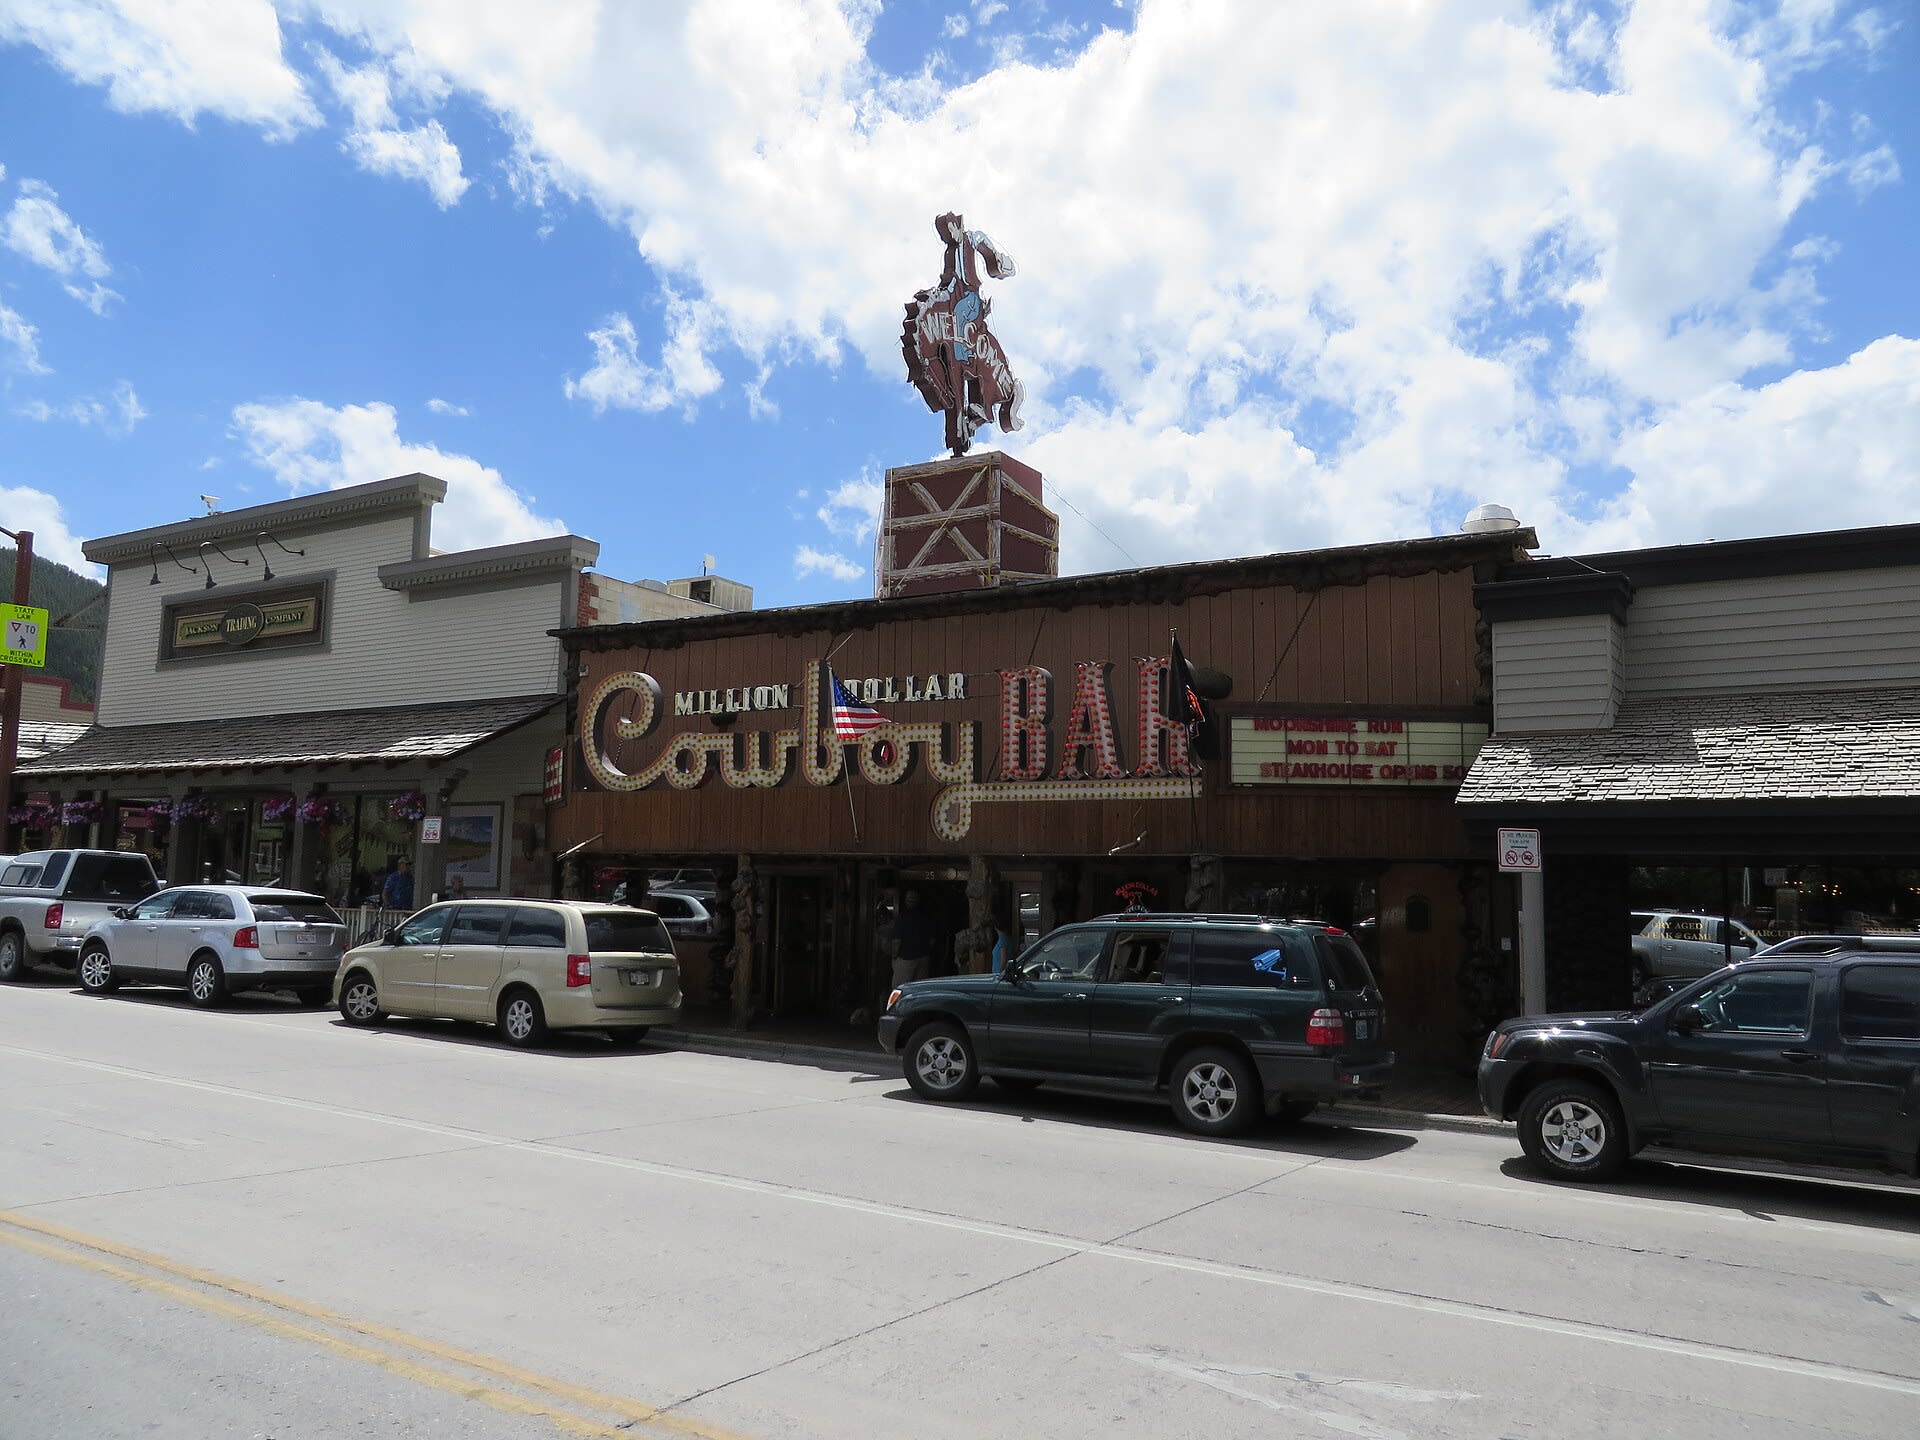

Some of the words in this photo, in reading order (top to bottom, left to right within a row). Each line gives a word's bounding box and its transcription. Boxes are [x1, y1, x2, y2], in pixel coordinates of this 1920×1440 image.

[921, 311, 1014, 400] WELCOME
[14, 606, 35, 615] STATE
[25, 624, 36, 635] TO
[184, 623, 218, 636] JACKSON
[226, 615, 257, 633] TRADING
[265, 611, 305, 626] COMPANY
[9, 649, 33, 658] WITHIN
[675, 683, 790, 716] MILLION
[1367, 719, 1404, 734] RUN
[582, 658, 980, 842] Cowboy
[998, 656, 1203, 782] BAR
[1287, 740, 1329, 756] MON
[1335, 740, 1359, 756] TO
[1365, 741, 1398, 757] SAT
[1260, 762, 1374, 779] STEAKHOUSE
[1379, 764, 1438, 780] OPENS
[1675, 922, 1704, 930] AGED
[1684, 932, 1712, 941] GAME
